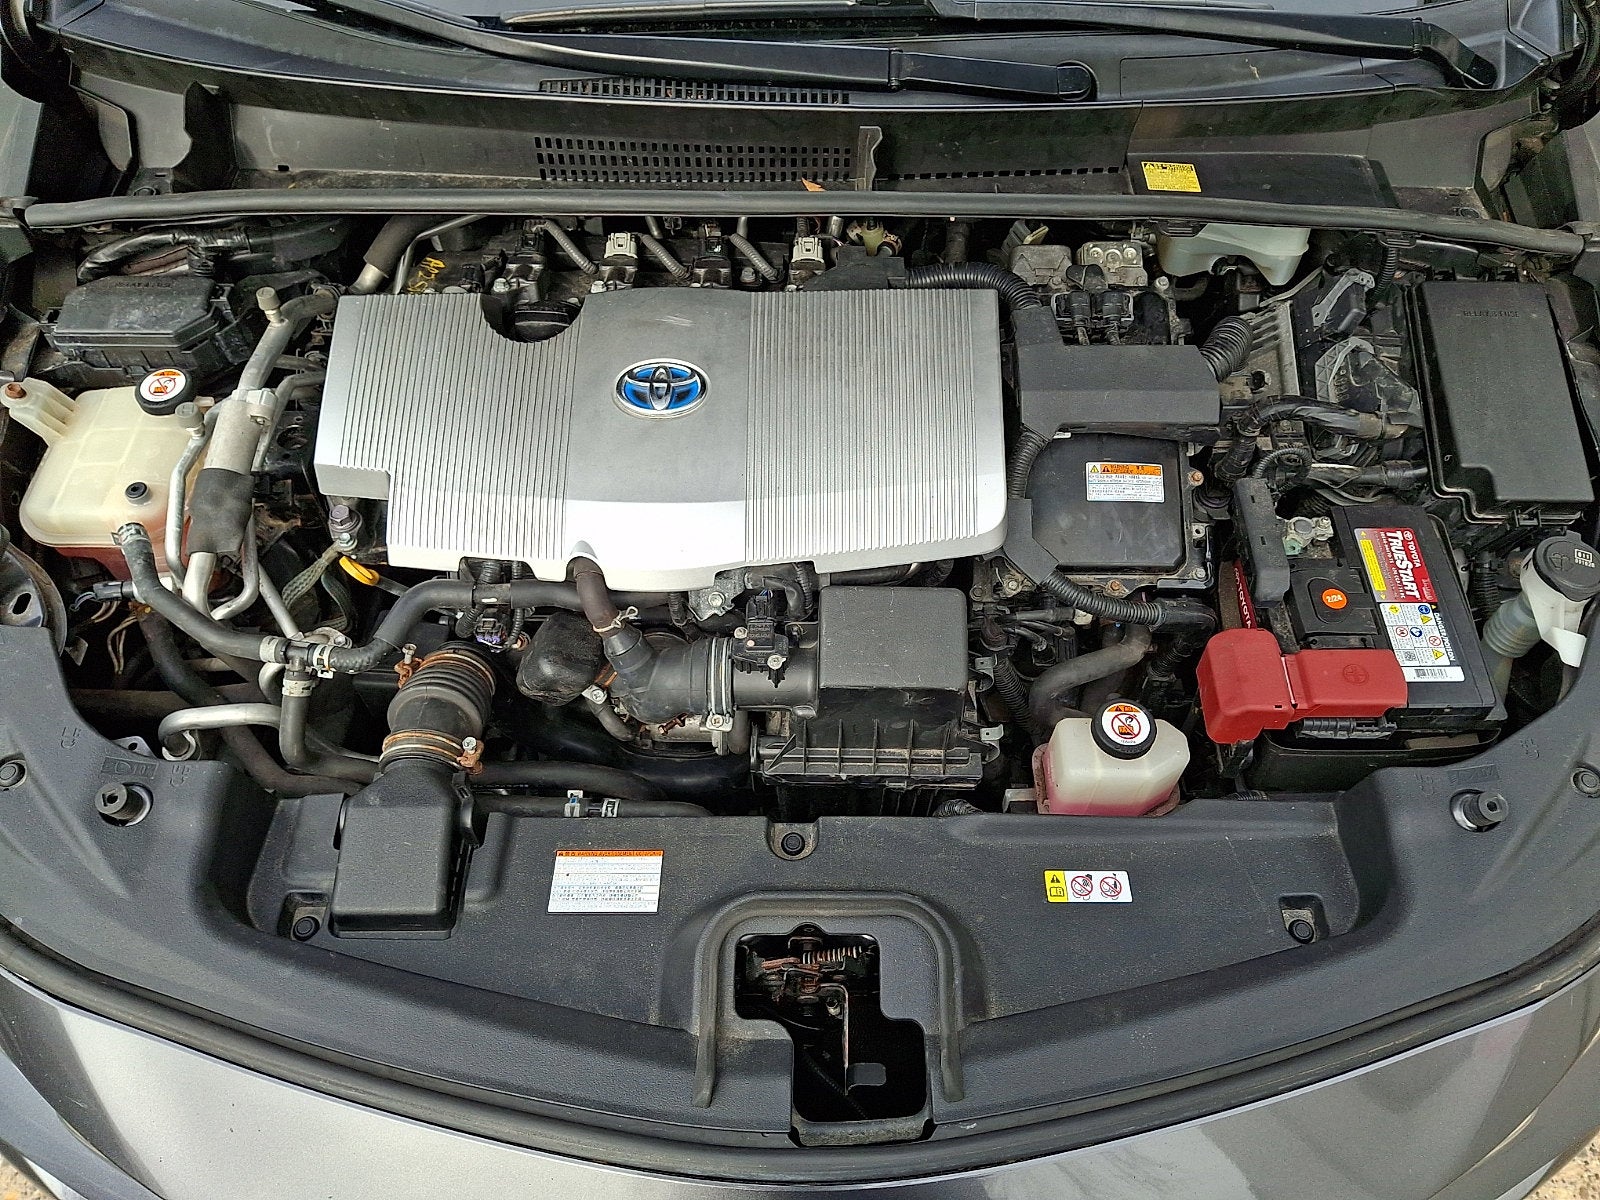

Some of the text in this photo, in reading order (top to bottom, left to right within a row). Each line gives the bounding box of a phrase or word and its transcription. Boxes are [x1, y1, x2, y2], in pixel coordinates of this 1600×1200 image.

[1407, 541, 1421, 567] TOYOTA
[1238, 583, 1251, 628] TOYOTA
[1326, 594, 1343, 603] 2/24
[1434, 612, 1456, 661] DANGER/POISON
